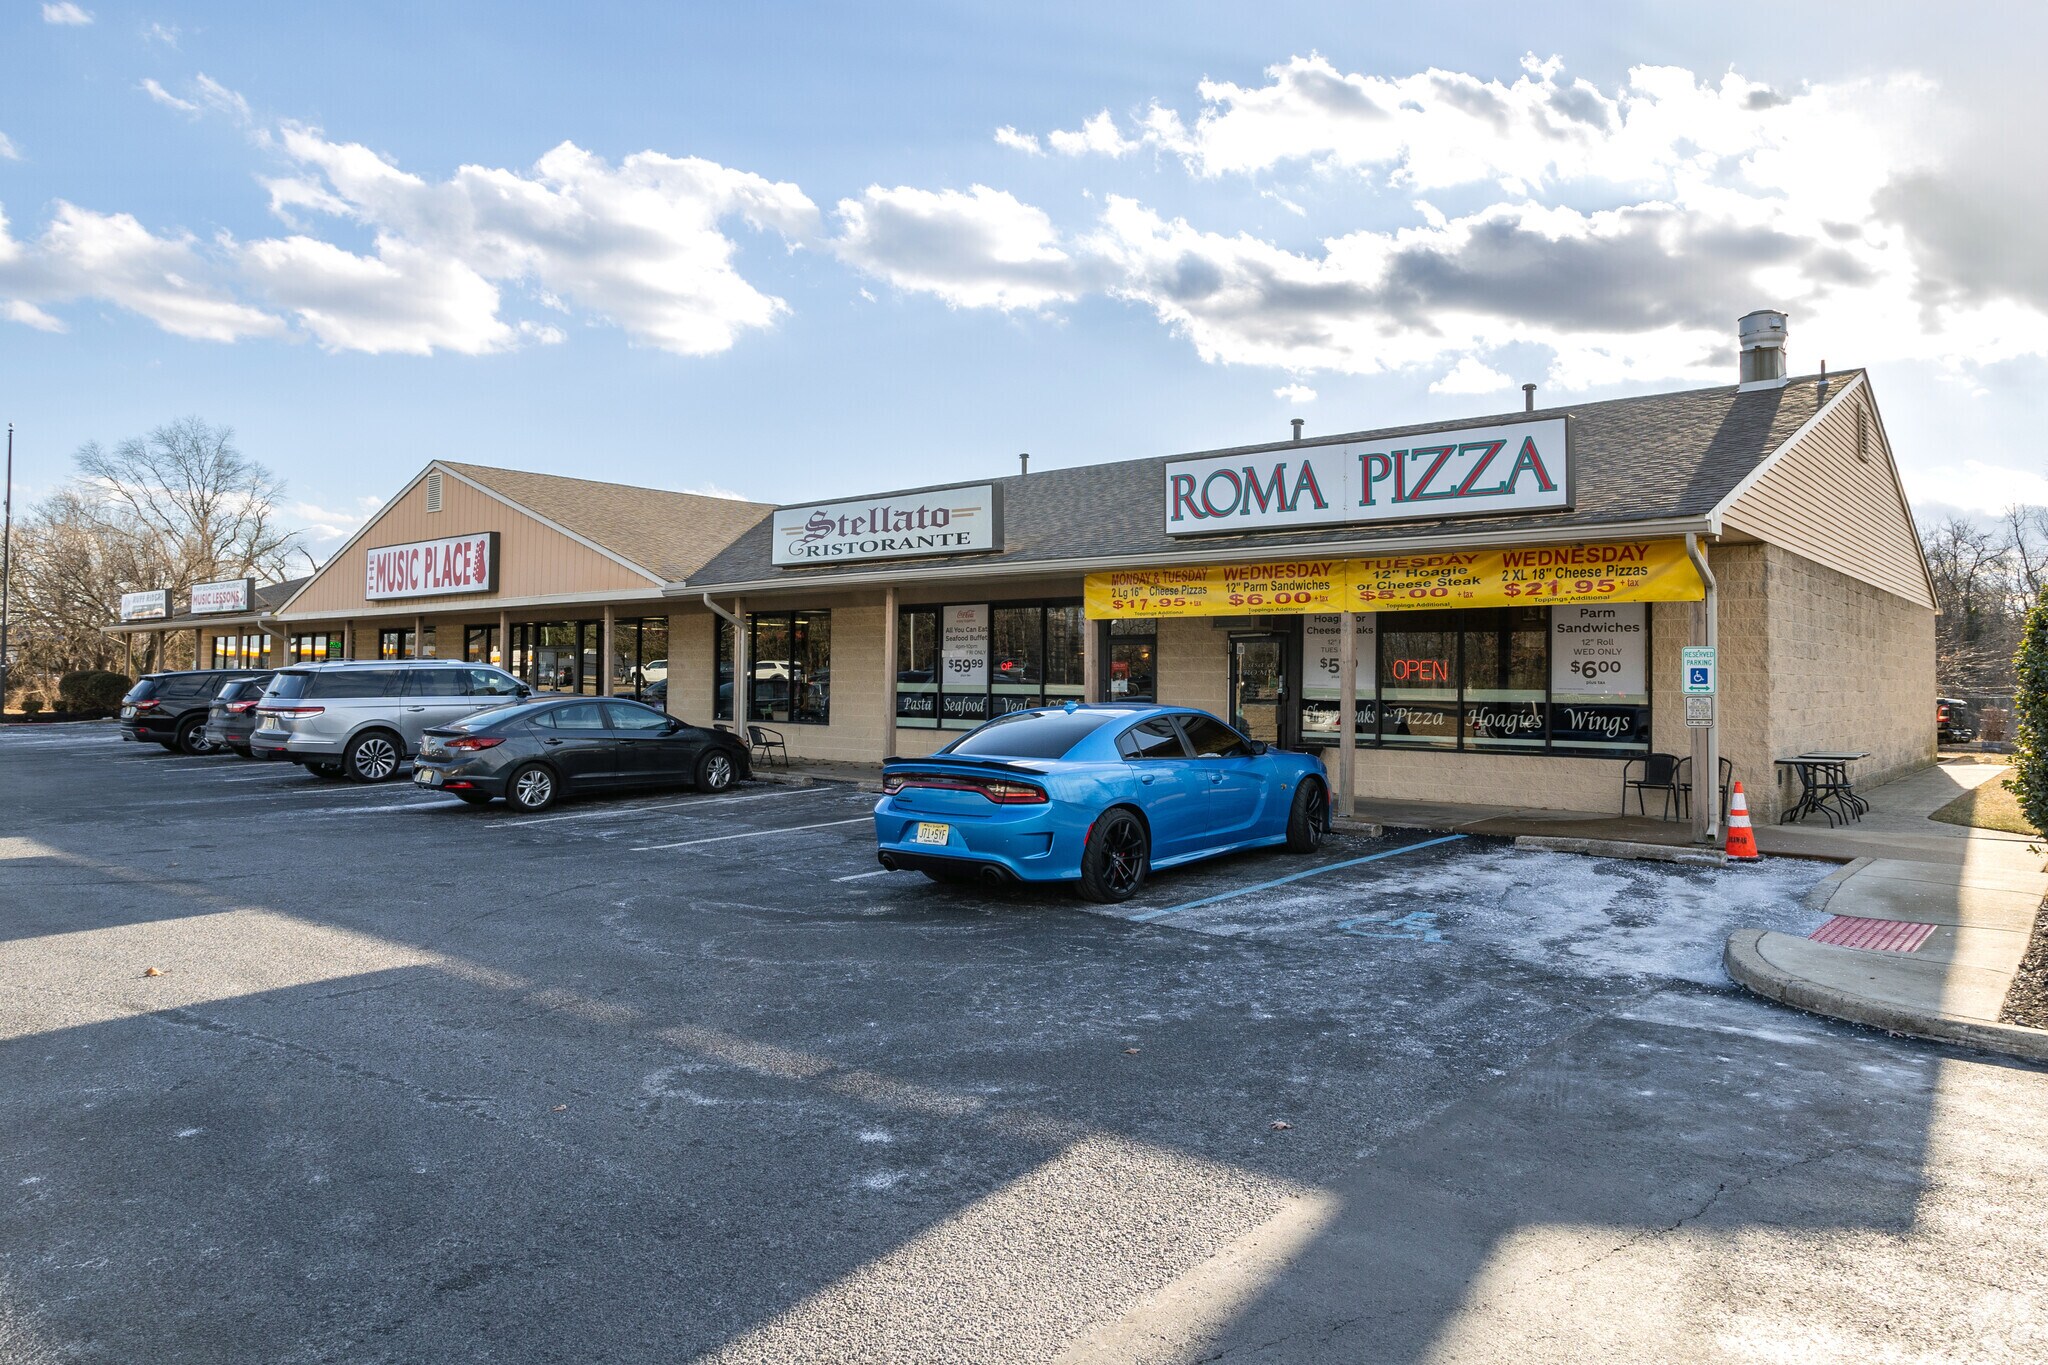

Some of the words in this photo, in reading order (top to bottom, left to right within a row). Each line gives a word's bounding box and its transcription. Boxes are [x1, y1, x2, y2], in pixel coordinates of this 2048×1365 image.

[1170, 459, 1329, 521] ROMA
[1358, 435, 1558, 507] PIZZA
[802, 504, 950, 541] Stellato
[805, 531, 971, 558] RISTORANTE
[1360, 554, 1479, 570] TUESDAY
[1502, 545, 1650, 567] WEDNESDAY
[376, 548, 419, 593] MUSIC
[424, 541, 472, 589] PLACE
[1223, 562, 1333, 581] WEDNESDAY
[1373, 569, 1400, 579] 12"
[1405, 566, 1468, 577] Hoagie
[1501, 569, 1508, 581] 2
[1512, 569, 1528, 581] XL
[1532, 567, 1552, 580] 18"
[1555, 566, 1602, 579] Cheese
[1606, 564, 1648, 577] Pizzas
[1111, 572, 1151, 586] MONDAY
[1153, 572, 1160, 584] &
[1162, 568, 1208, 584] TUESDAY
[1376, 580, 1432, 590] Cheese
[1437, 576, 1481, 587] Steak
[1111, 588, 1116, 598] 2
[1118, 588, 1128, 600] Lg
[1149, 585, 1179, 597] Cheese
[1181, 584, 1208, 595] Pizzas
[1225, 582, 1240, 593] 12"
[1243, 581, 1268, 592] Parm
[1270, 580, 1330, 591] Sandwiches
[1359, 587, 1449, 601] $5.00
[1463, 590, 1474, 599] tax
[1503, 579, 1616, 597] $21.95
[1627, 578, 1640, 587] tax
[193, 593, 211, 605] MUSIC
[212, 590, 240, 604] LESSONS
[1112, 597, 1186, 611] $17.95
[1228, 591, 1312, 606] $6.00
[1580, 608, 1616, 618] Parm
[1306, 626, 1374, 635] Cheeseaks
[1557, 622, 1640, 633] Sandwiches
[1596, 638, 1614, 646] Roll
[1573, 648, 1596, 656] WED
[1597, 648, 1622, 656] ONLY
[1392, 659, 1450, 682] OPEN
[904, 697, 933, 711] Pasta
[943, 697, 987, 717] Seafood
[1001, 697, 1030, 713] Veal
[1393, 706, 1445, 726] Pizza
[1465, 706, 1543, 735] Hoagies
[1564, 708, 1630, 738] Wings
